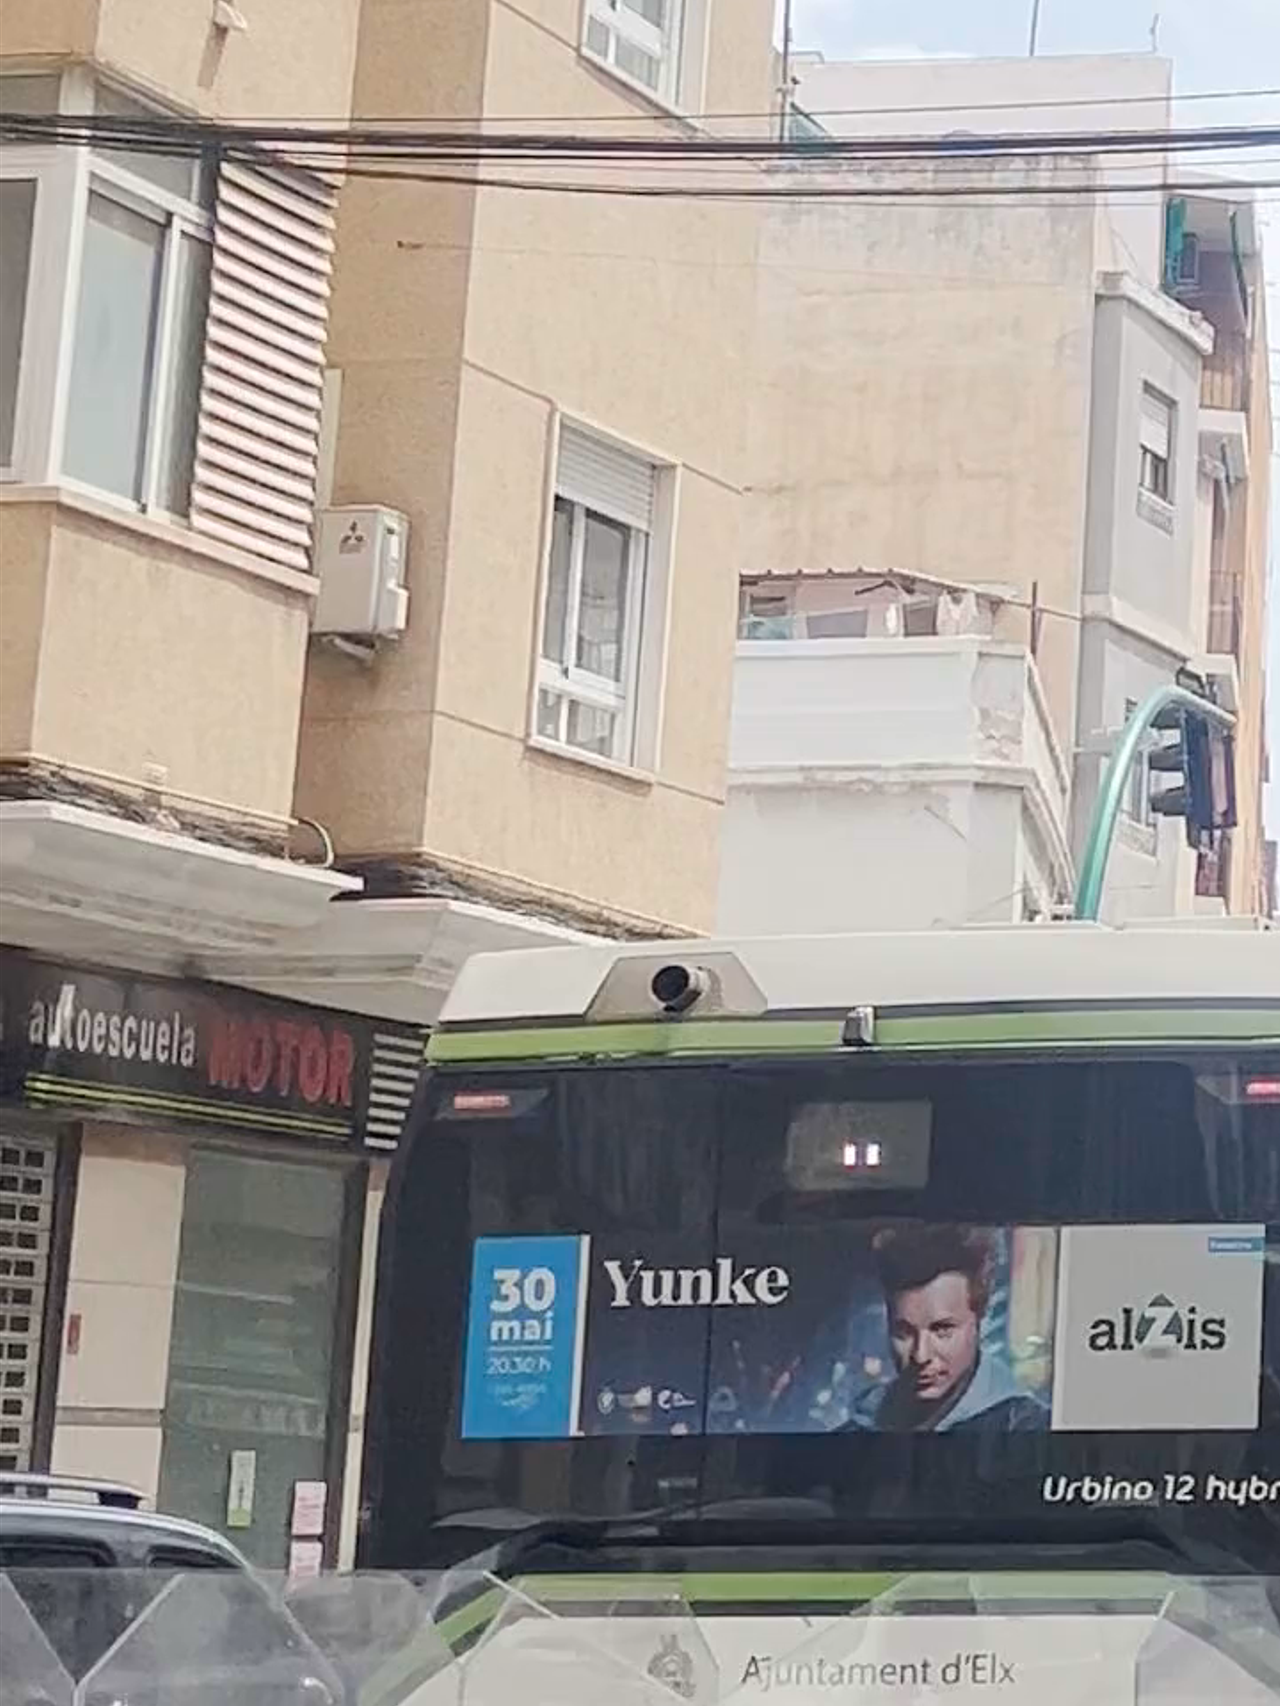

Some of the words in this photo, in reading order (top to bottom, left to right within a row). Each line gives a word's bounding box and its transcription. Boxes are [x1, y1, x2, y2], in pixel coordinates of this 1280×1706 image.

[28, 983, 198, 1068] autoescuela
[208, 1012, 355, 1106] MOTOR
[490, 1268, 556, 1312] 30
[603, 1257, 790, 1307] Yunke
[489, 1311, 554, 1341] mai
[1042, 1474, 1154, 1502] Urbino
[1162, 1474, 1196, 1501] 12
[741, 1654, 931, 1692] Ajuntament
